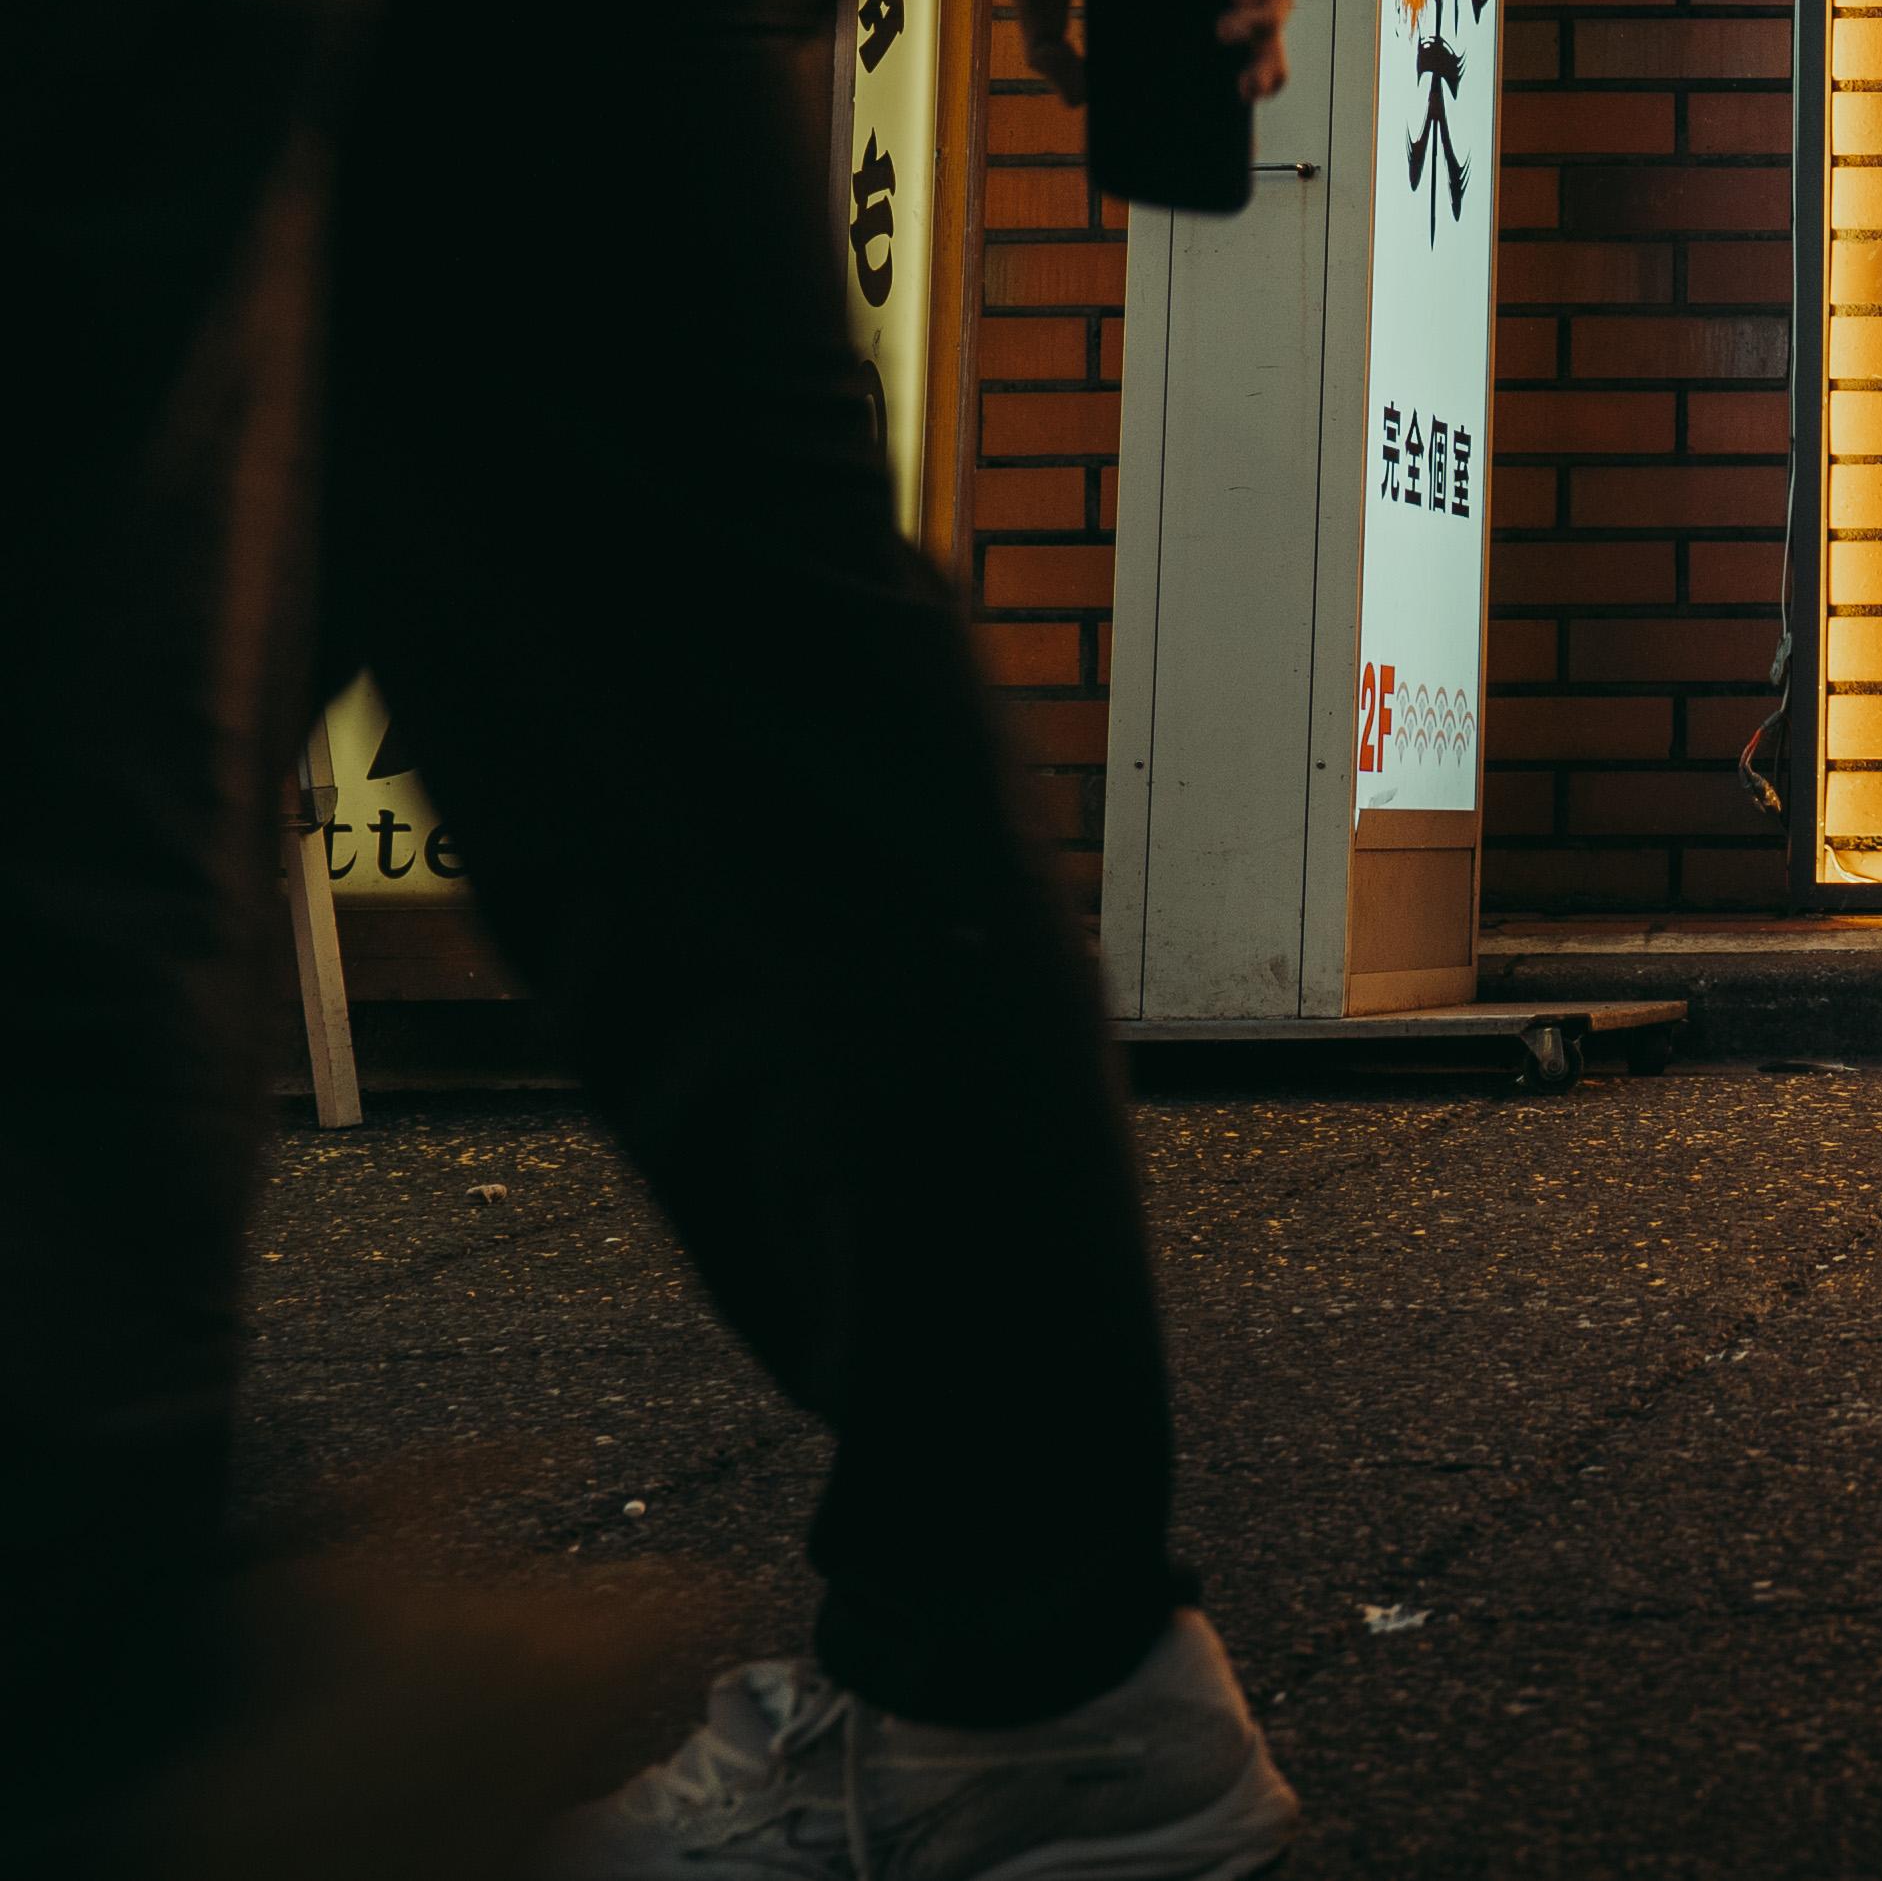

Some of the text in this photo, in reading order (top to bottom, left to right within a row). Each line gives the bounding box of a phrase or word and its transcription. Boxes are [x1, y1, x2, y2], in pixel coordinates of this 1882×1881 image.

[1380, 401, 1472, 518] 完全個室
[1358, 661, 1395, 773] 2F
[320, 808, 468, 880] tte
